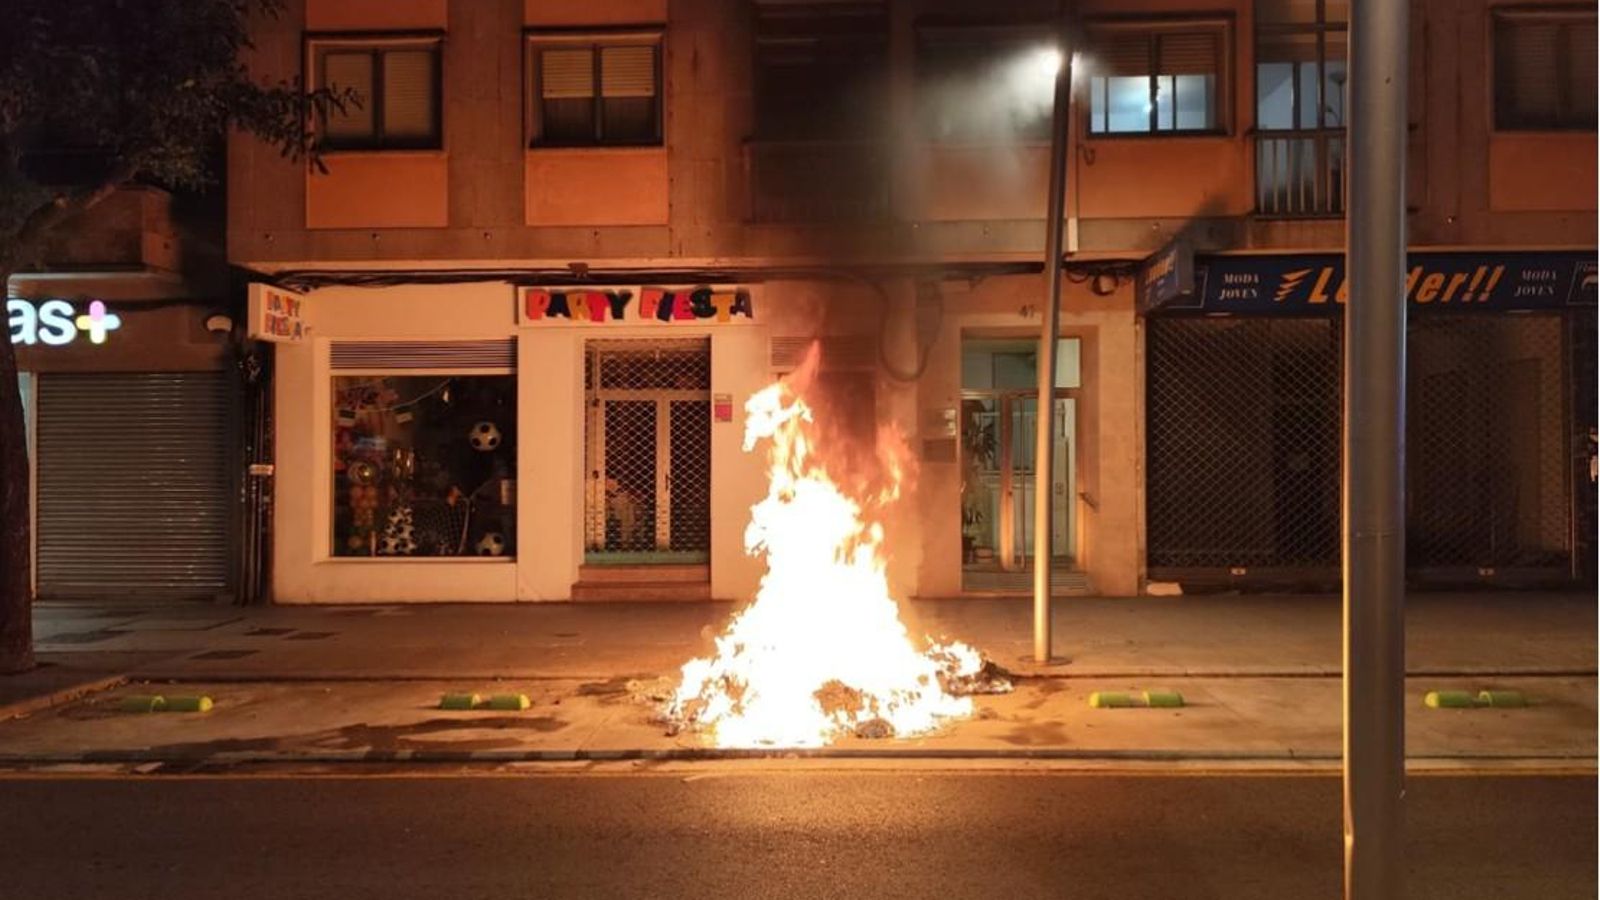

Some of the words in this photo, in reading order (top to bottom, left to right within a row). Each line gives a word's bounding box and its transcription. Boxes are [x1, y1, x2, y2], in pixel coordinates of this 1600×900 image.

[1308, 266, 1504, 303] Ler!!
[525, 288, 633, 322] PARTY
[638, 286, 753, 322] FIESTA
